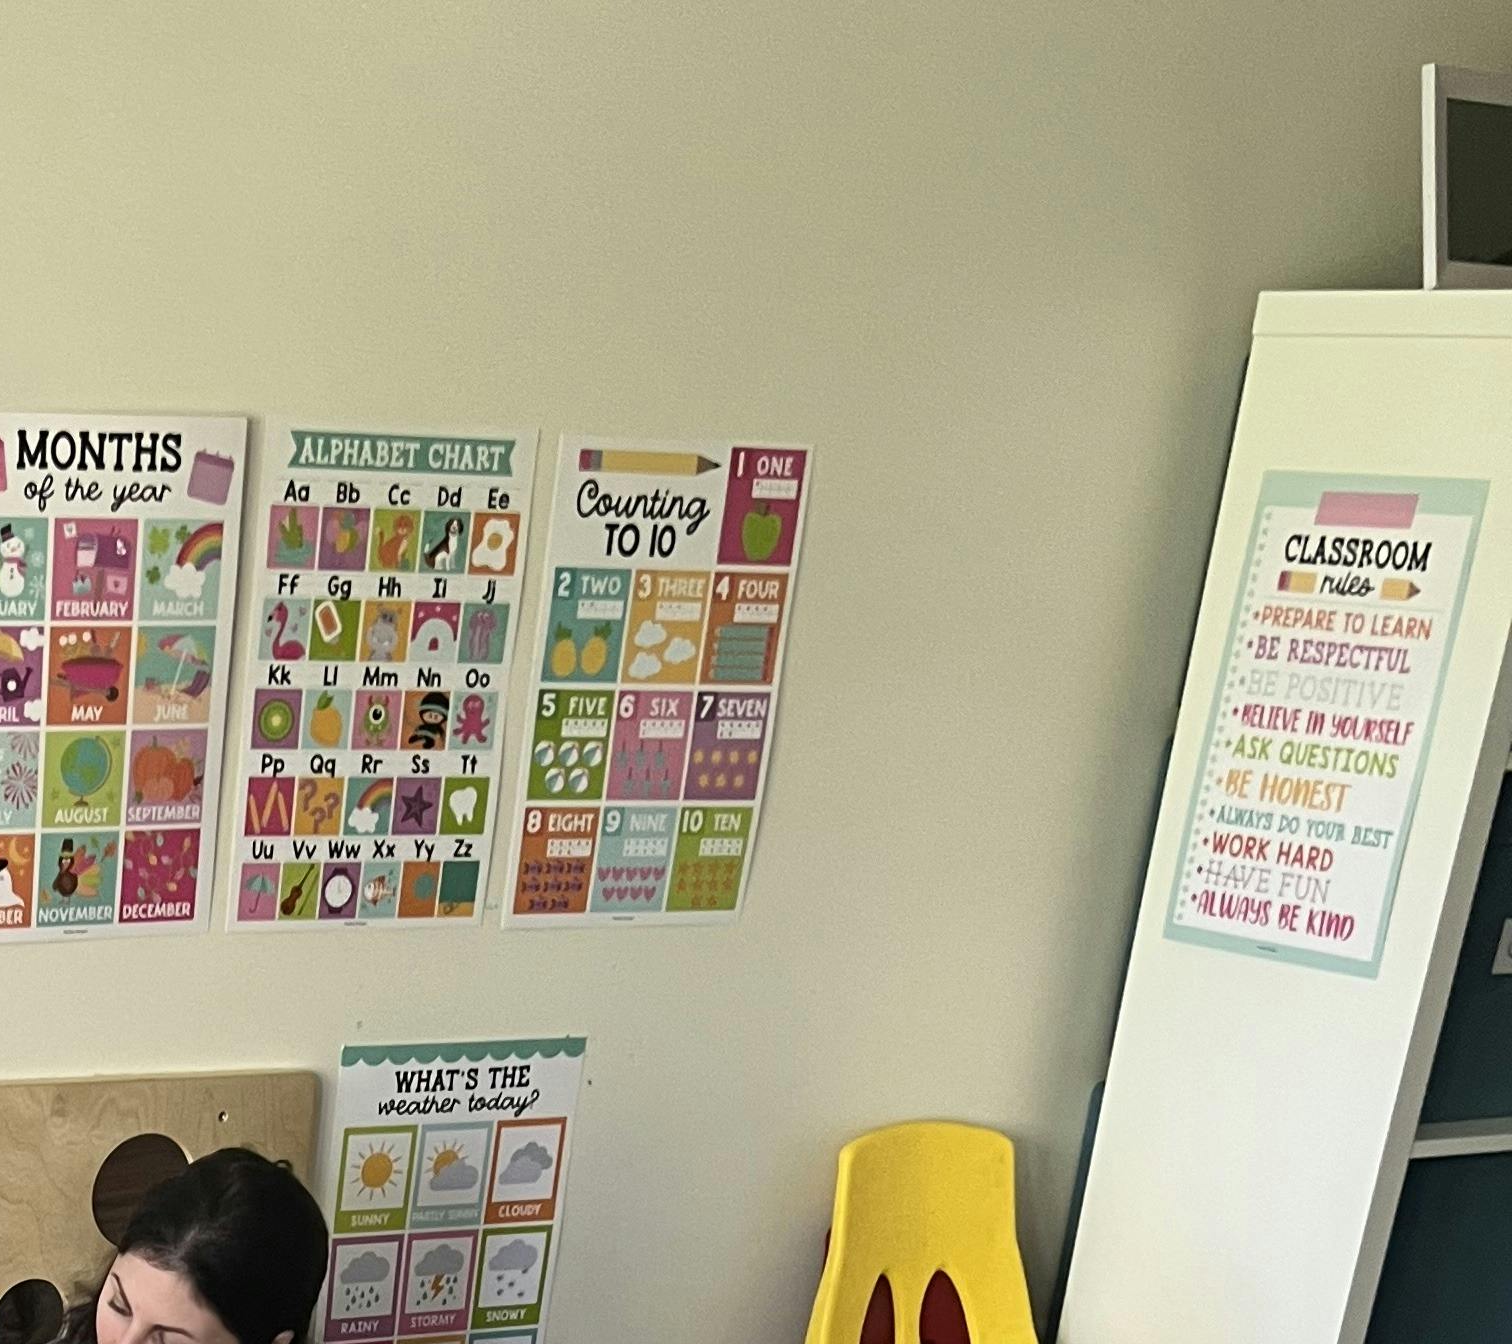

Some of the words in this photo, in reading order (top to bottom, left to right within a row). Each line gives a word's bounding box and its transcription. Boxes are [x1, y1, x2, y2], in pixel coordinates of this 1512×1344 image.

[16, 430, 182, 473] MONTHS
[298, 437, 420, 469] ALPHABET
[428, 442, 505, 473] CHART
[736, 451, 745, 477] 1
[757, 456, 793, 475] ONE
[24, 474, 54, 512] of
[65, 477, 102, 501] the
[111, 482, 171, 513] year
[284, 480, 309, 503] Aa
[336, 483, 360, 504] Bb
[388, 485, 410, 506] Cc
[437, 487, 461, 508] Dd
[487, 489, 509, 510] Ee
[577, 480, 710, 534] Counting
[605, 523, 639, 558] TO
[650, 525, 676, 557] 10
[1284, 535, 1432, 571] CLASSROOM
[278, 574, 300, 596] Ff
[328, 576, 351, 601] Gg
[379, 577, 401, 598] Hh
[432, 578, 447, 599] Ii
[482, 580, 496, 604] Jj
[558, 572, 570, 597] 2
[582, 576, 621, 595] TWO
[639, 574, 651, 598] 3
[658, 578, 704, 597] THREE
[716, 576, 729, 599] 4
[738, 579, 780, 598] FOUR
[1320, 573, 1375, 596] rules
[55, 600, 127, 618] FEBRUARY
[152, 600, 204, 618] MARCH
[1260, 607, 1336, 632] PREPARE
[1342, 613, 1365, 634] TO
[1371, 614, 1432, 640] LEARN
[1255, 637, 1279, 660] BE
[1288, 640, 1412, 674] RESPECTFUL
[268, 664, 291, 686] Kk
[323, 665, 338, 686] Ll
[363, 667, 398, 687] Mm
[417, 667, 442, 687] Nn
[465, 668, 490, 688] Oo
[1247, 670, 1276, 696] BE
[1288, 674, 1404, 711] POSITIVE
[71, 705, 102, 722] MAY
[153, 704, 188, 722] JUNE
[542, 693, 556, 716] 5
[568, 697, 606, 717] FIVE
[620, 694, 634, 718] 6
[651, 697, 679, 716] SIX
[700, 696, 713, 720] 7
[718, 699, 767, 718] SEVEN
[1241, 706, 1300, 732] BELIEVE
[1331, 715, 1414, 746] YOURSELF
[261, 755, 285, 778] Pp
[310, 755, 336, 778] Qq
[362, 755, 382, 774] Rr
[411, 755, 430, 775] Ss
[460, 754, 478, 774] Tt
[1233, 735, 1270, 760] ASK
[1280, 741, 1400, 778] QUESTIONS
[1225, 769, 1254, 798] BE
[55, 807, 108, 824] AUGUST
[127, 805, 200, 822] SEPTEMBER
[527, 810, 541, 833] 8
[549, 813, 593, 832] EIGHT
[606, 810, 620, 833] 9
[630, 813, 667, 832] NINE
[683, 810, 703, 833] 10
[714, 813, 741, 832] TEN
[1217, 806, 1273, 830] ALWAYS
[1278, 815, 1300, 835] DO
[1306, 819, 1345, 842] YOUR
[1352, 826, 1394, 849] BEST
[252, 840, 274, 860] Uu
[293, 841, 317, 859] Vv
[328, 840, 360, 859] Ww
[372, 840, 395, 859] Xx
[414, 839, 435, 861] Yy
[454, 839, 473, 858] Zz
[1211, 832, 1270, 860] WORK
[1277, 843, 1334, 872] HARD
[1205, 861, 1269, 892] HAVE
[1279, 873, 1330, 903] FUN
[38, 905, 112, 923] NOVEMBER
[122, 901, 190, 920] DECEMBER
[1197, 890, 1270, 925] ALWAYS
[1278, 902, 1299, 931] BE
[395, 1067, 479, 1093] WHAT'S
[488, 1065, 531, 1089] THE
[378, 1095, 460, 1117] weather
[469, 1089, 540, 1117] today?
[351, 1213, 389, 1227] SUNNY
[499, 1203, 542, 1217] CLOUDY
[341, 1320, 379, 1334] RAINY
[410, 1314, 456, 1327] STORMY
[486, 1308, 527, 1322] SNOWY
